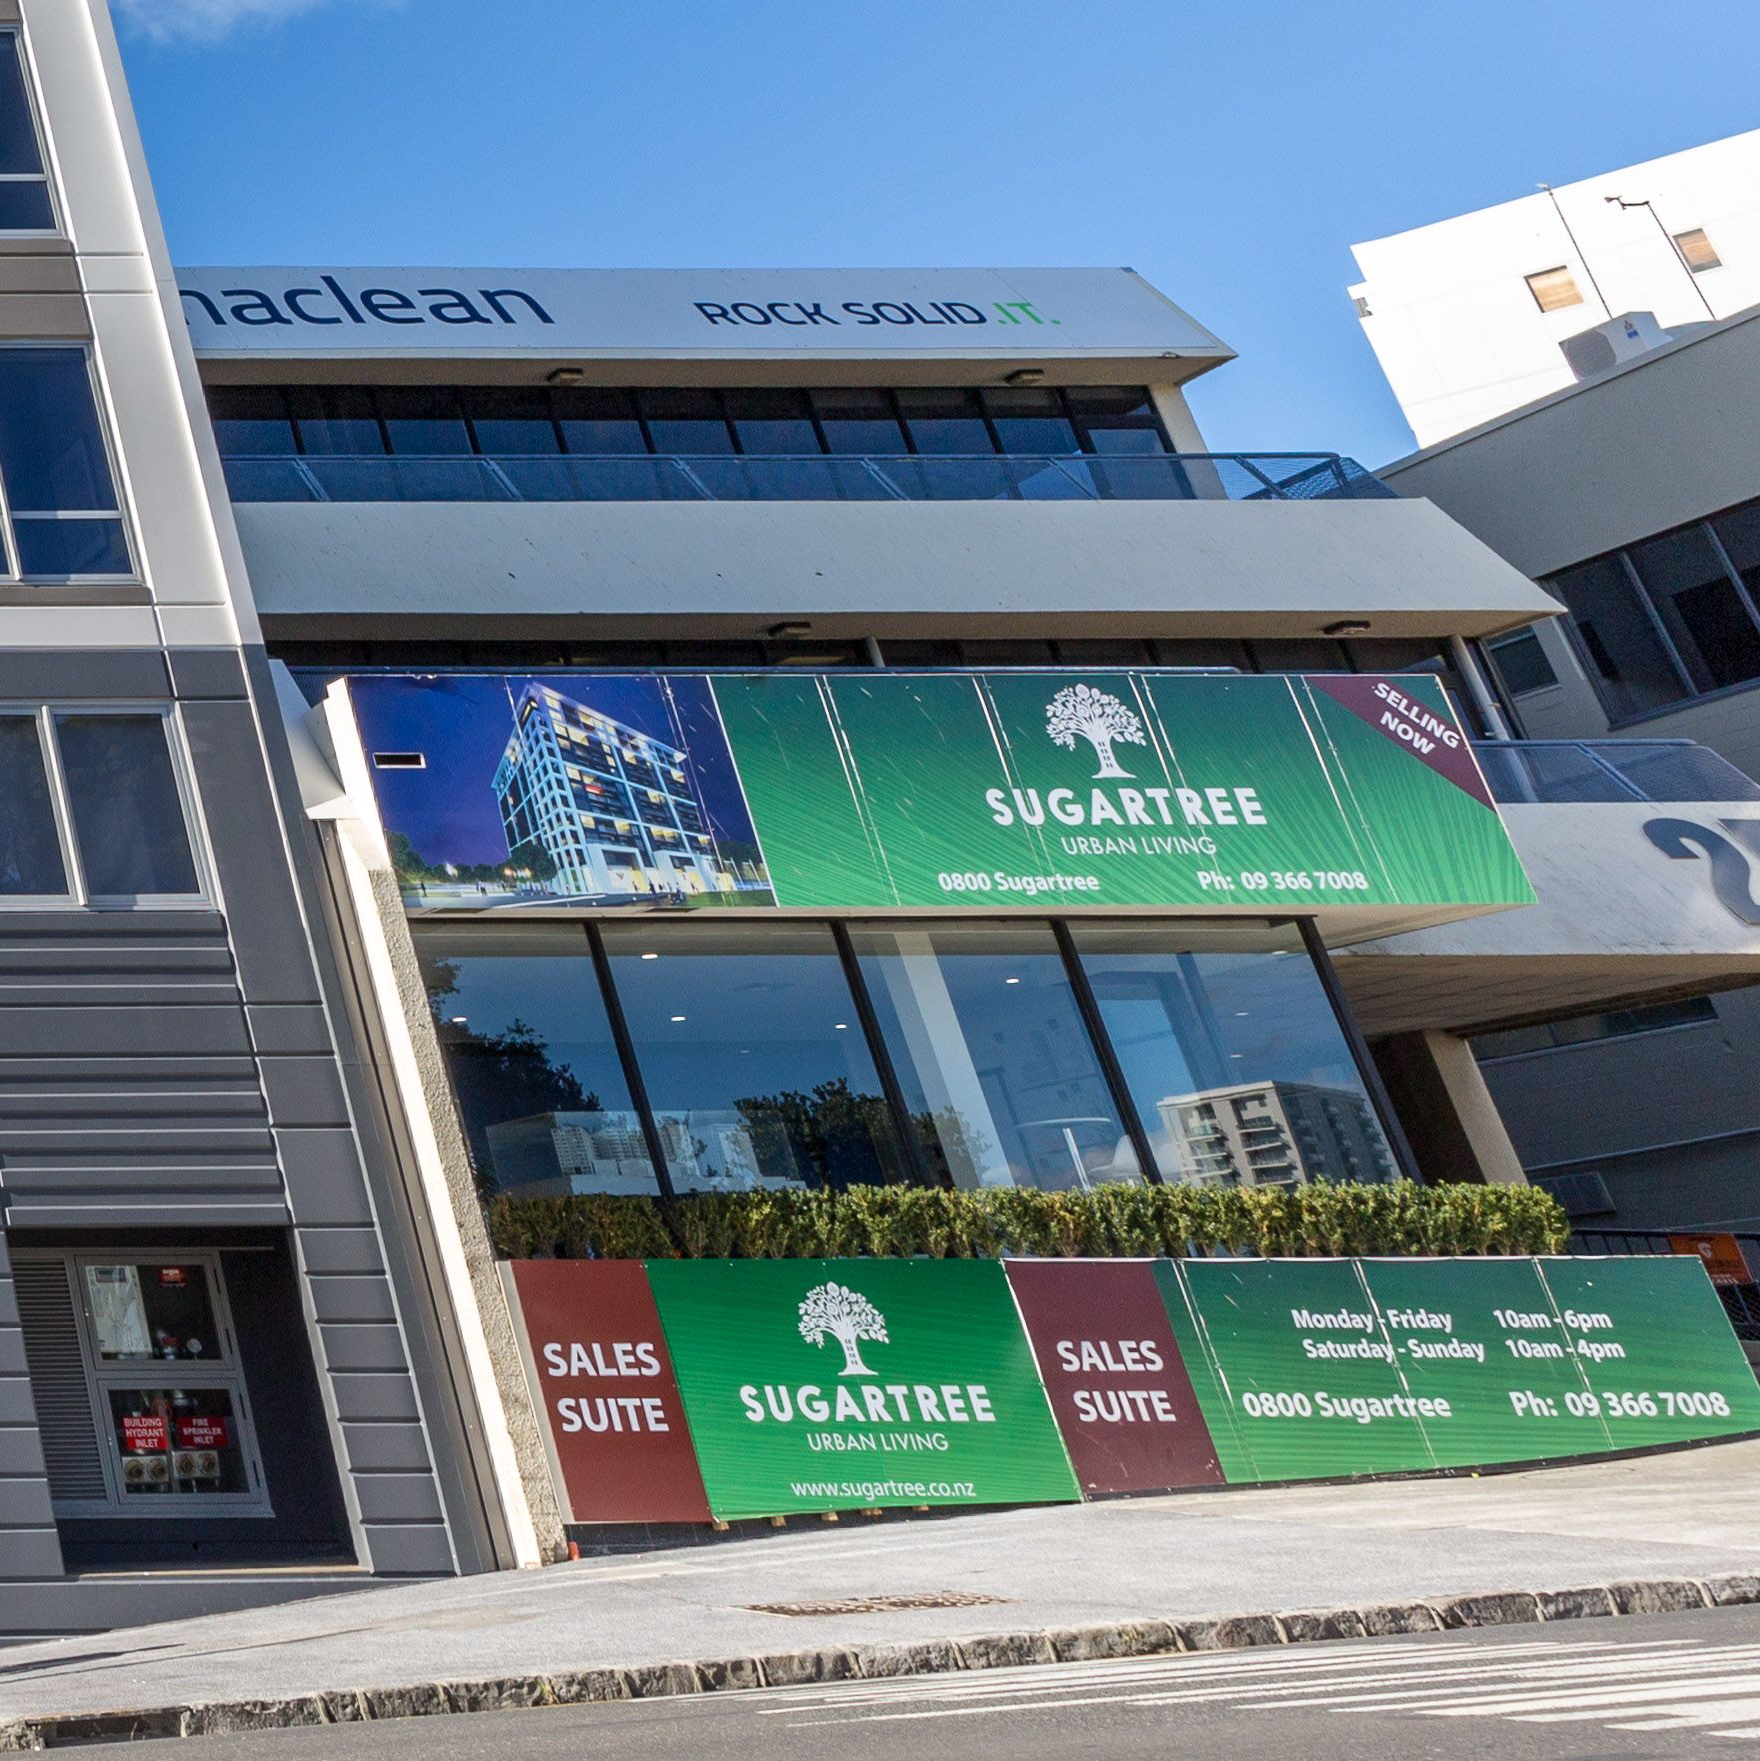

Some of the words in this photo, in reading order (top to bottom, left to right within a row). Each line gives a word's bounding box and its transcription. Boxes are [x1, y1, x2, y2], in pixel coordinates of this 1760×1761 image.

[692, 302, 841, 326] ROCK
[841, 302, 988, 326] SOLID
[1373, 682, 1460, 749] SELLING
[1380, 711, 1436, 755] NOW
[985, 787, 1268, 826] SUGARTREE
[1060, 836, 1138, 856] URBAN
[1140, 836, 1217, 856] LIVING
[937, 871, 991, 891] 0800
[996, 871, 1100, 896] Sugartree
[1197, 870, 1235, 891] Ph:
[1240, 871, 1268, 890] 09
[1270, 871, 1312, 890] 366
[1313, 871, 1368, 890] 7008
[1290, 1309, 1373, 1333] Monday
[1386, 1309, 1452, 1333] Friday
[1492, 1309, 1552, 1328] 10am
[1564, 1309, 1614, 1333] 6pm
[542, 1342, 661, 1377] SALES
[1056, 1339, 1164, 1373] SALES
[1302, 1338, 1394, 1363] Saturday
[1407, 1338, 1485, 1363] Sunday
[1505, 1338, 1564, 1358] 10am
[1577, 1338, 1626, 1363] 4pm
[557, 1396, 670, 1432] SUITE
[739, 1384, 997, 1423] SUGARTREE
[1072, 1390, 1178, 1423] SUITE
[1242, 1392, 1312, 1418] 0800
[1313, 1391, 1453, 1424] Sugartree
[1508, 1391, 1559, 1417] Ph:
[1563, 1392, 1600, 1417] 09
[1602, 1392, 1658, 1417] 366
[1658, 1392, 1731, 1417] 7008
[123, 1417, 162, 1427] BUILDING
[125, 1428, 165, 1438] HYDRANT
[183, 1427, 222, 1435] SPRINKLER
[192, 1418, 209, 1426] FIRE
[135, 1439, 159, 1448] INLET
[193, 1436, 214, 1444] INLET
[807, 1433, 876, 1452] URBAN
[881, 1433, 948, 1452] LIVING
[790, 1478, 977, 1501] www.sugartree.co.nz
